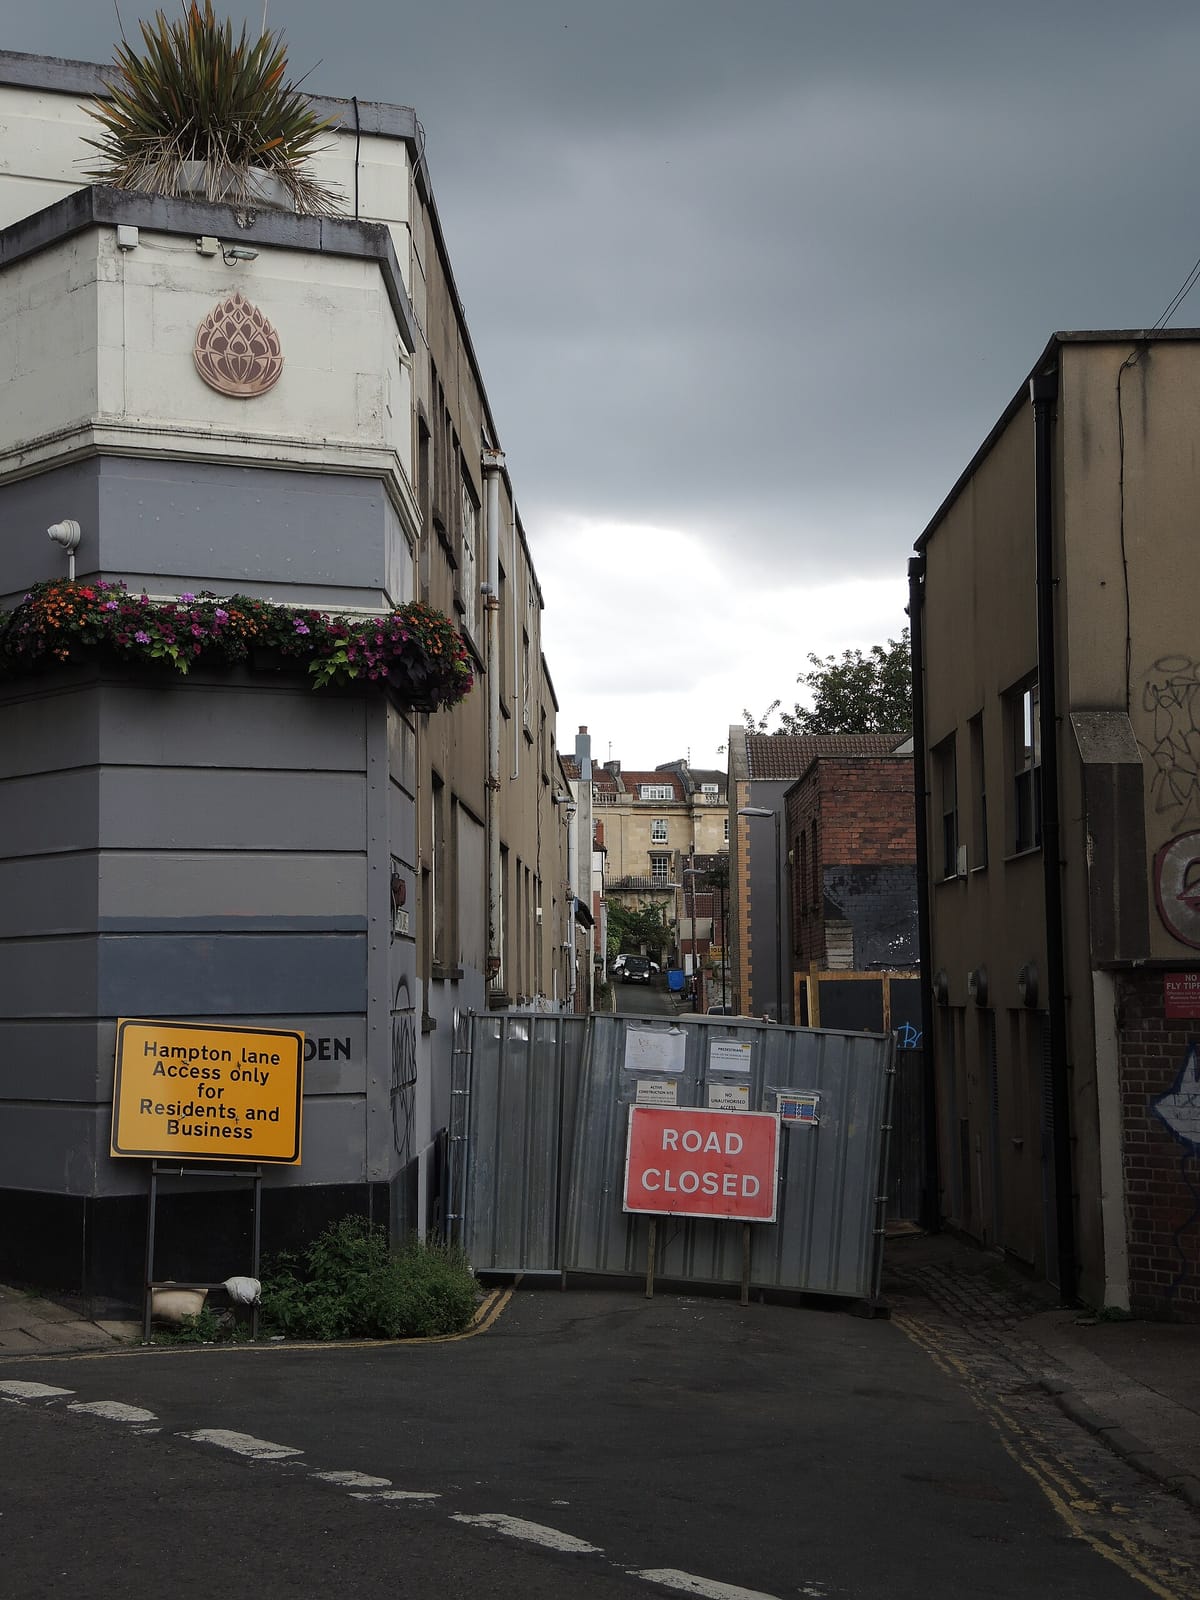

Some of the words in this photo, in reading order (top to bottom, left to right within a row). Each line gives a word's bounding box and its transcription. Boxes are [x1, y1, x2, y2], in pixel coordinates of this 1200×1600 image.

[1166, 982, 1182, 990] FLY
[143, 1040, 232, 1062] Hampton
[241, 1047, 281, 1065] lane
[152, 1060, 221, 1080] Access
[230, 1067, 270, 1086] only
[197, 1082, 225, 1099] for
[140, 1098, 237, 1119] Residents
[245, 1106, 280, 1122] and
[167, 1119, 253, 1139] Business
[662, 1128, 744, 1155] ROAD
[641, 1168, 760, 1197] CLOSED
